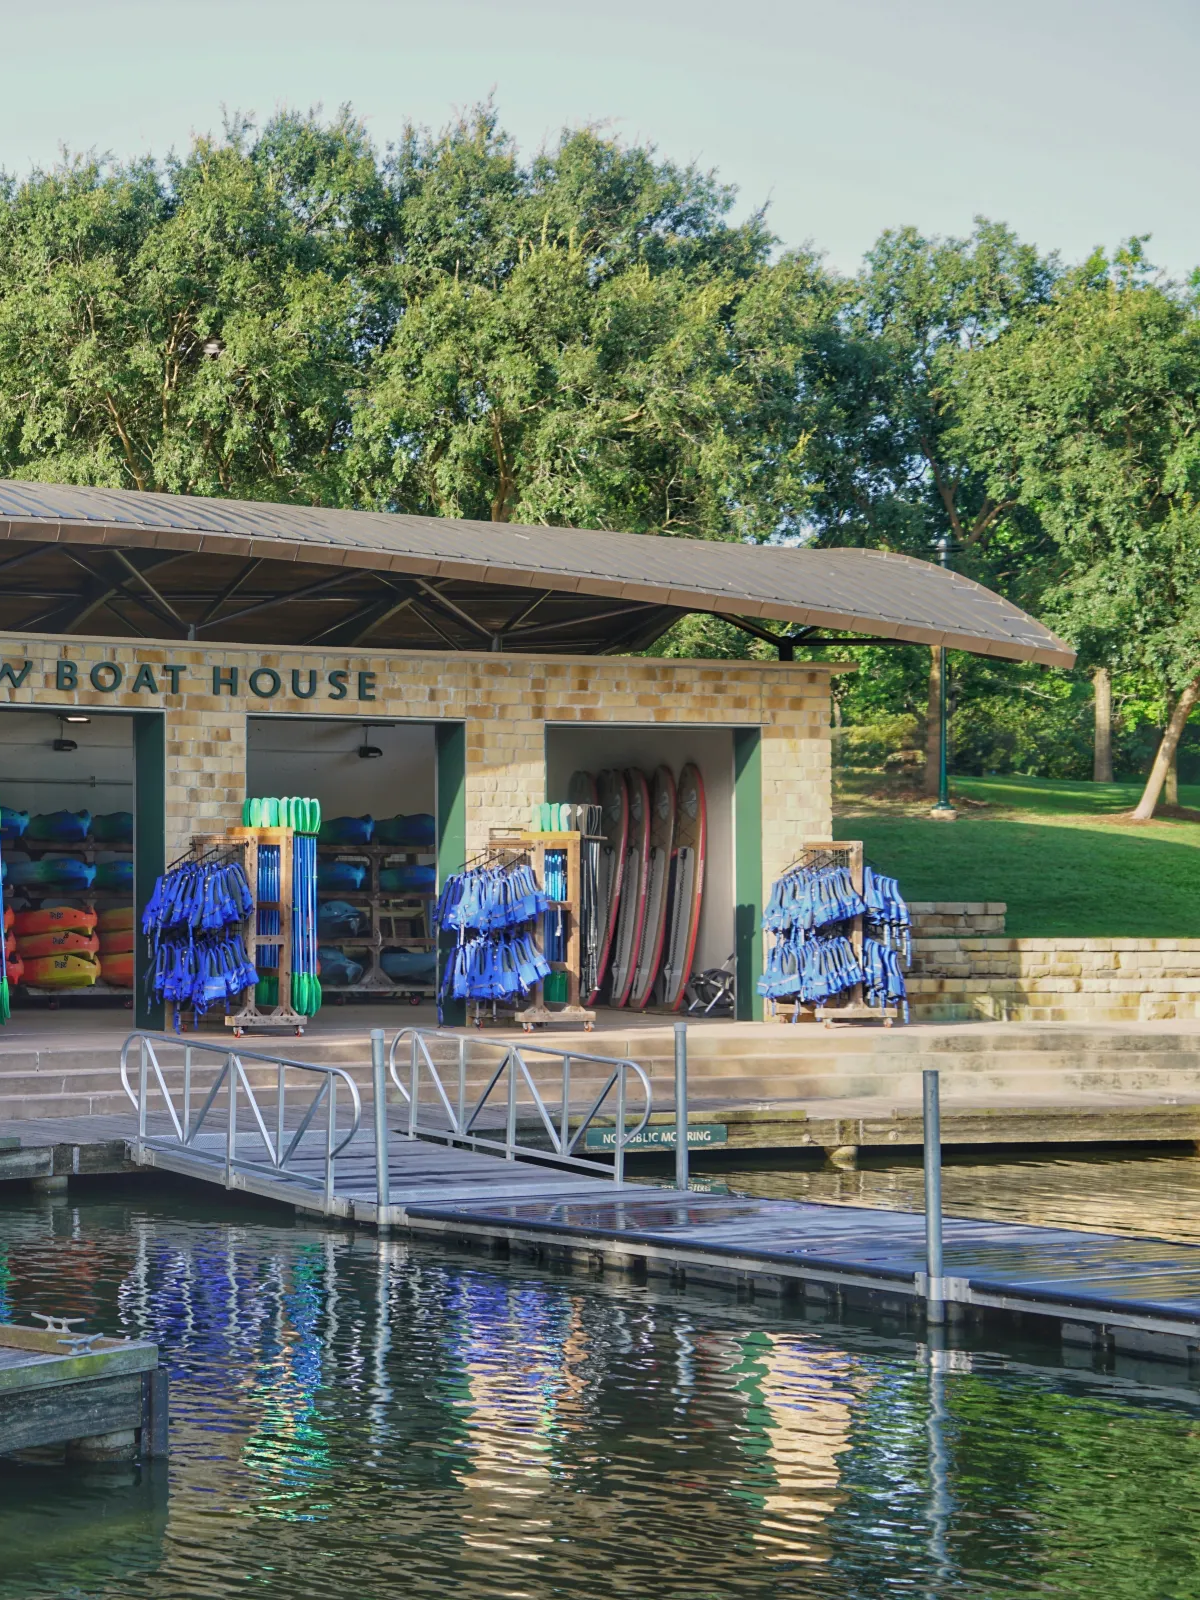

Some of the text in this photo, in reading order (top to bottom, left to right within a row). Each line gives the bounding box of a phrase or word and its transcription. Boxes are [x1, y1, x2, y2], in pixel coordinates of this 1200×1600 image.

[57, 659, 187, 695] BOAT
[214, 666, 377, 701] HOUSE
[660, 1130, 711, 1143] MORING
